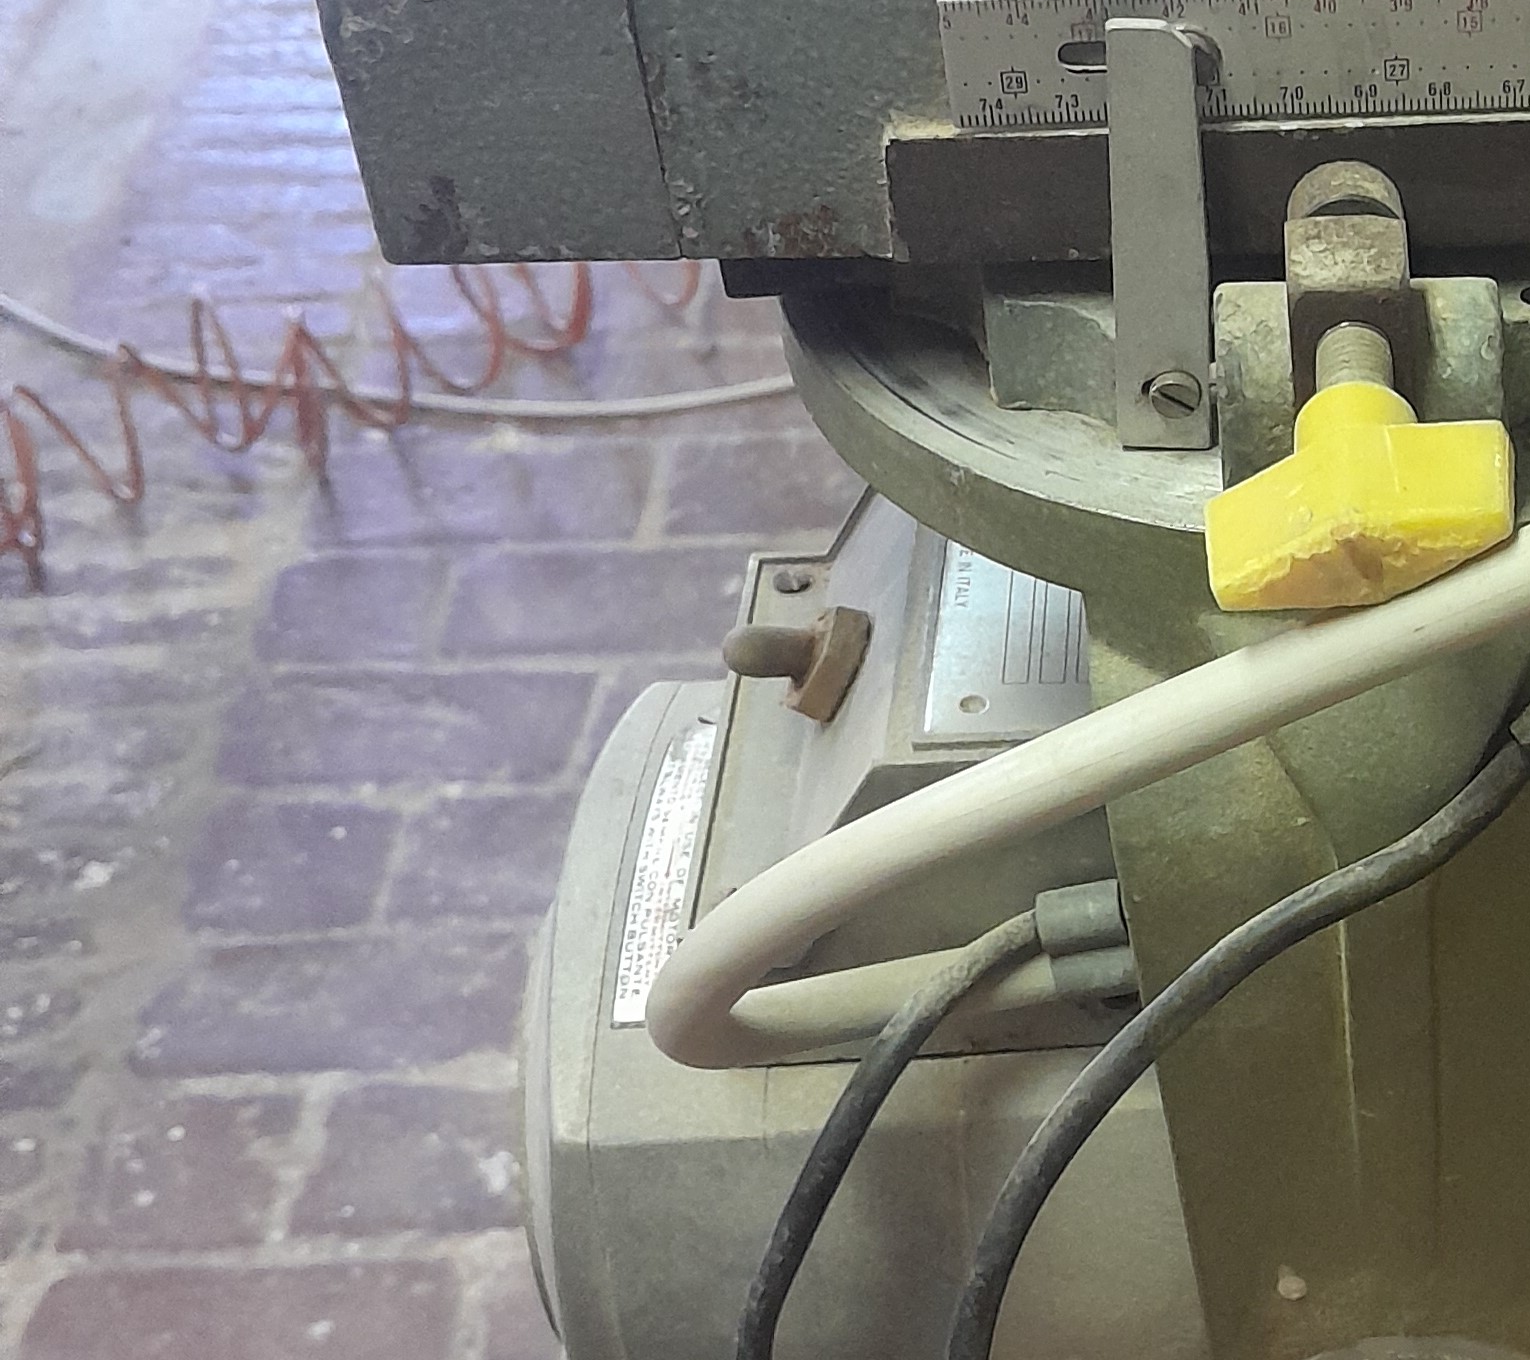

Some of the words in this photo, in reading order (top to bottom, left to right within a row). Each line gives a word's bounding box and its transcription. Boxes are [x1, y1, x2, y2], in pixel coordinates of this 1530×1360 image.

[1006, 13, 1029, 26] 44
[1162, 3, 1184, 18] 42
[1314, 0, 1337, 13] 40
[1005, 76, 1024, 90] 29
[1389, 64, 1406, 77] 27
[979, 98, 1003, 112] 74
[1054, 94, 1079, 109] 73
[1280, 85, 1304, 100] 70
[1428, 82, 1451, 96] 68
[1503, 79, 1525, 94] 67
[955, 576, 971, 608] ITALY
[629, 864, 648, 925] SWITCH
[618, 929, 637, 1000] BUTTON
